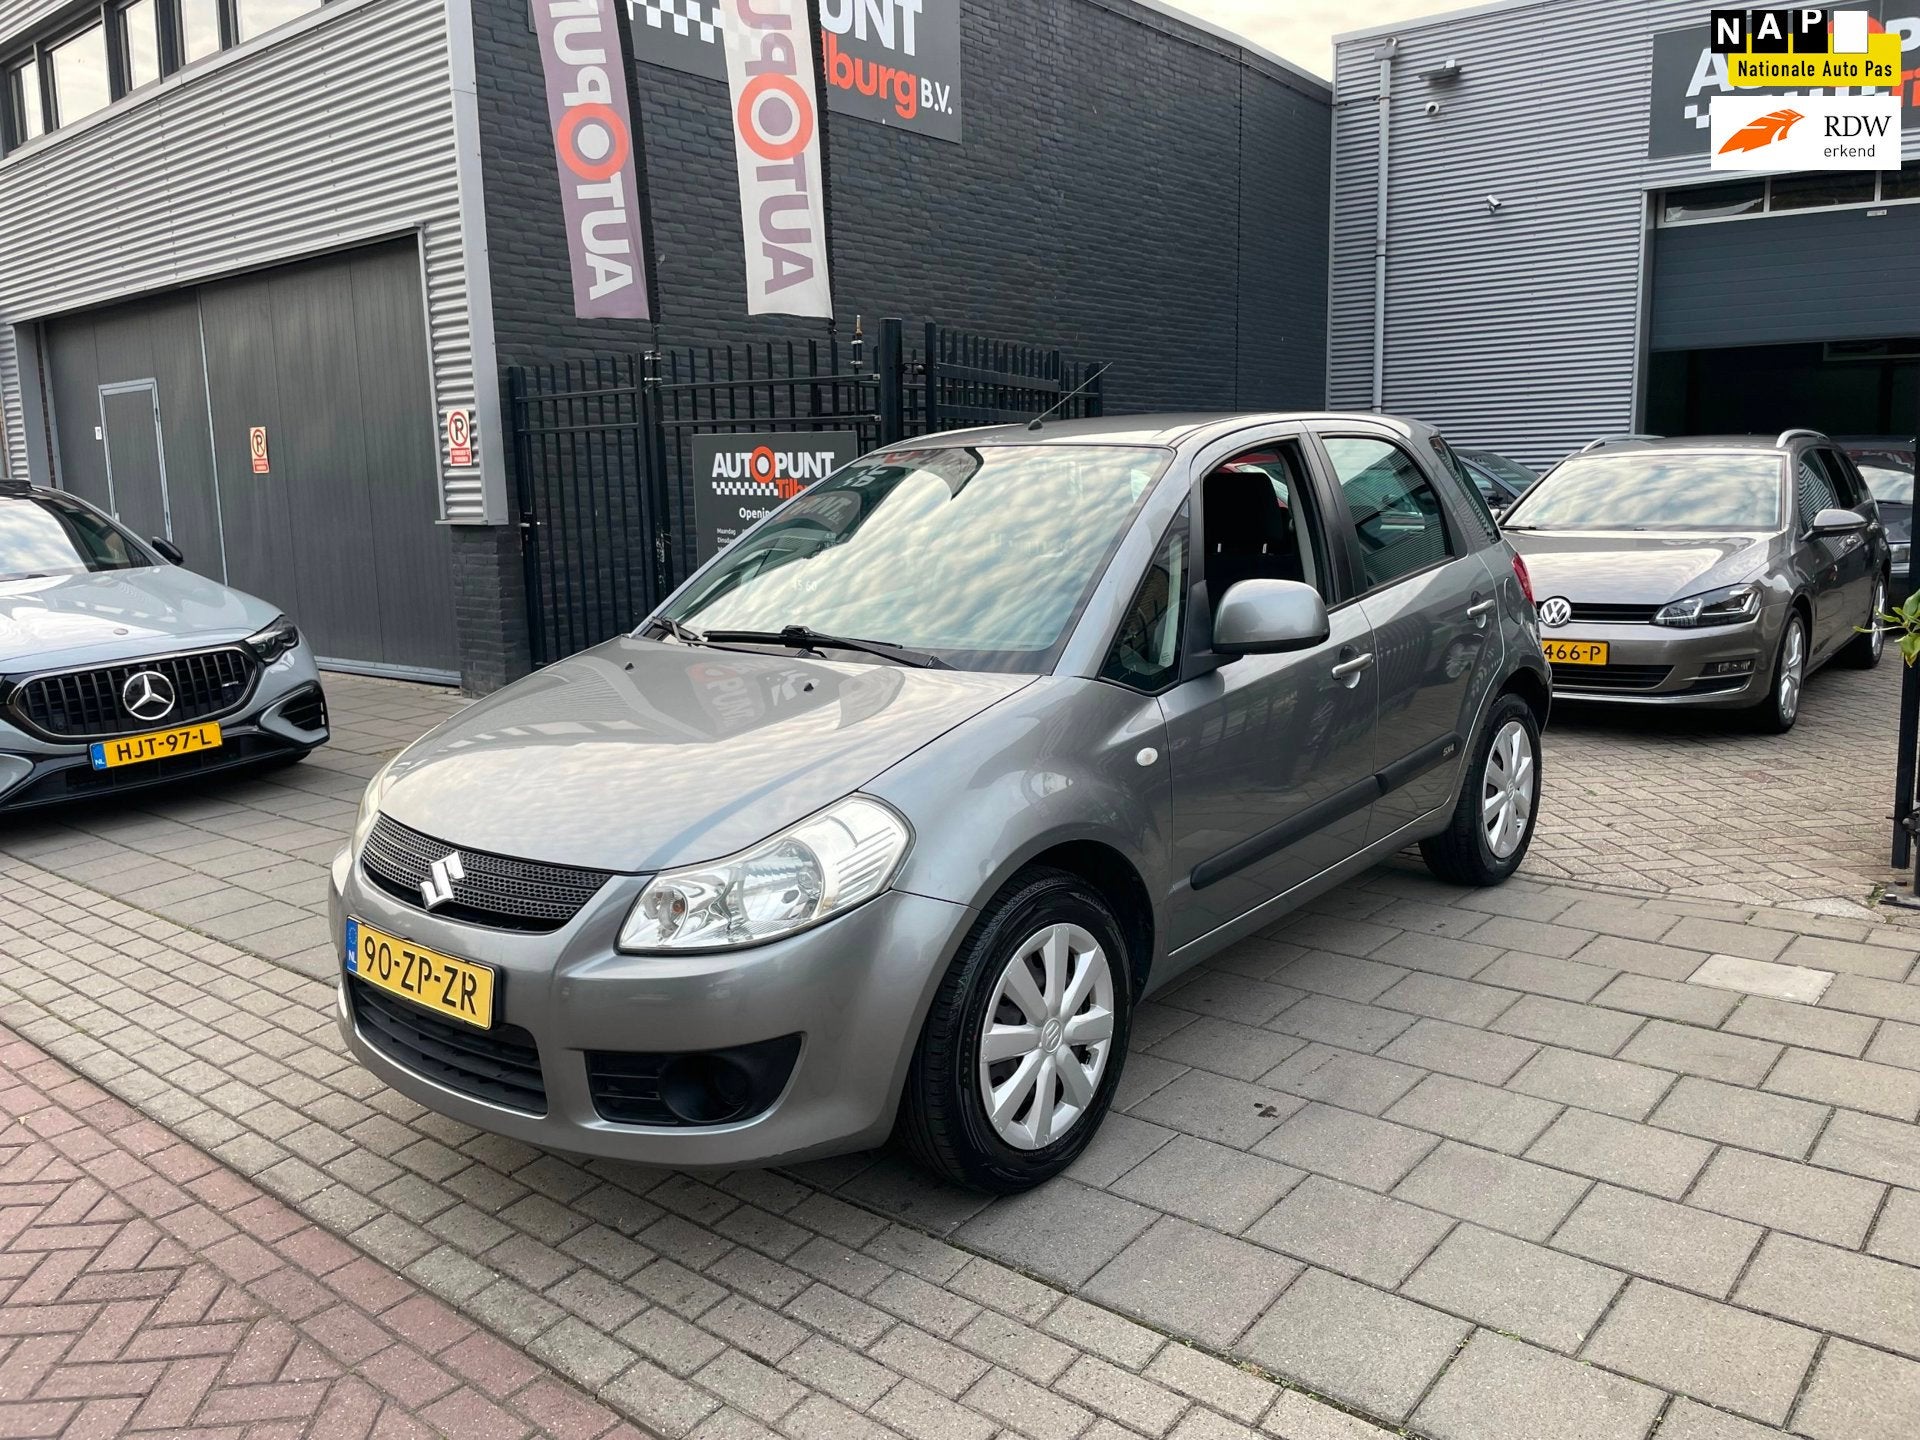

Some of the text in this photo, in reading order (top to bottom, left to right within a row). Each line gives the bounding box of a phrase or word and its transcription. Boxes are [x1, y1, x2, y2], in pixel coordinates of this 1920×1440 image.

[820, 0, 922, 56] UNT
[821, 28, 953, 119] burg B.V.
[712, 446, 834, 483] AUTOPUNT
[775, 478, 807, 499] Tilb
[739, 507, 771, 521] Openin
[717, 528, 736, 537] Maandag
[1544, 644, 1601, 661] 466-P
[117, 729, 212, 761] HJT-97-L
[364, 936, 477, 1015] 90-ZP-ZR
